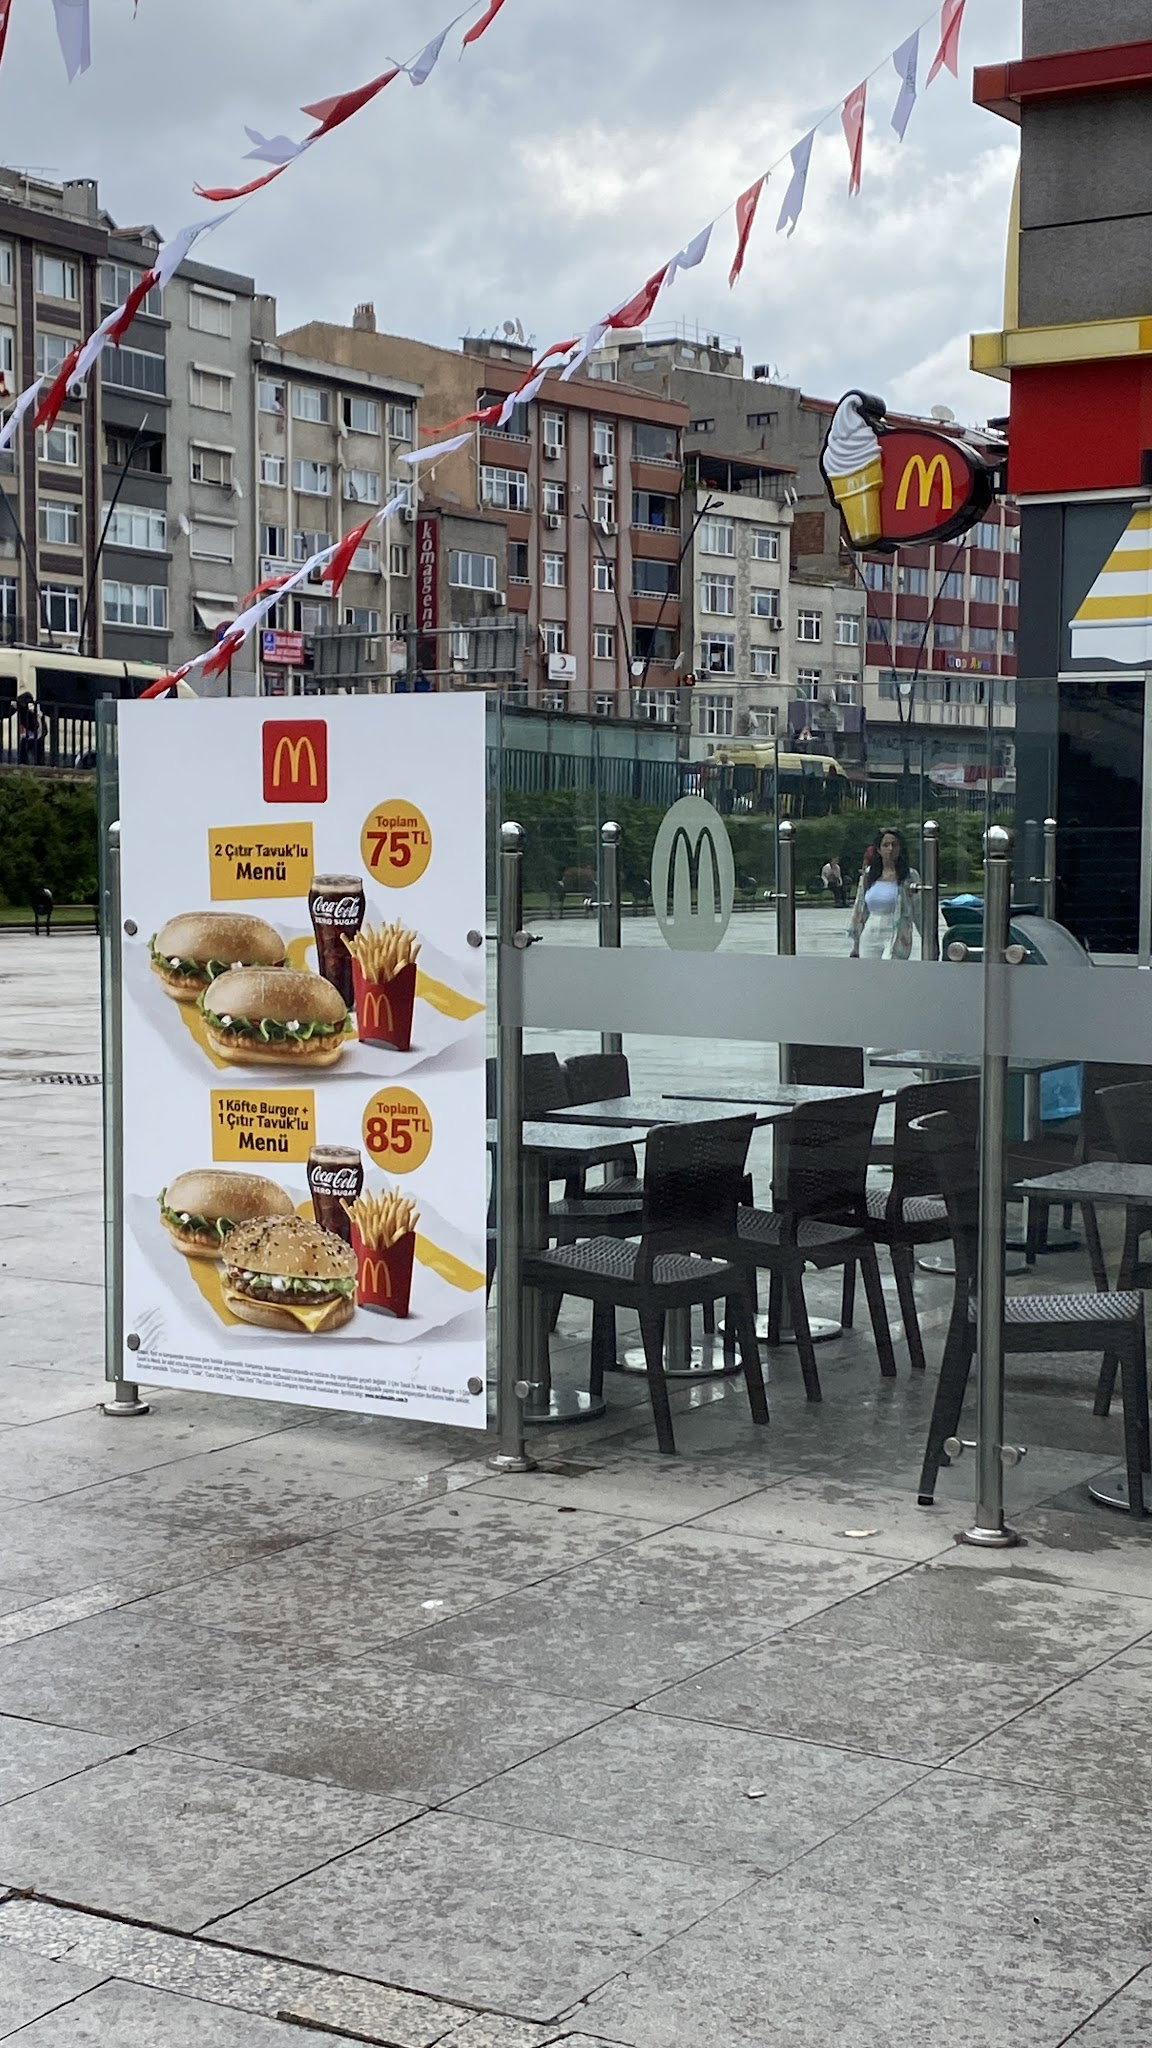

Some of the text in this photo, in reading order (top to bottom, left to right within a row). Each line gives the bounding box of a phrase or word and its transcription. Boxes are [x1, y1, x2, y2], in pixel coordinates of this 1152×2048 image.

[896, 454, 952, 510] M
[272, 736, 317, 786] M
[375, 815, 418, 830] Toplam
[215, 844, 308, 861] 2 Çıtır Tavuk'lu
[236, 862, 286, 881] Menü
[315, 917, 359, 926] ZERO SUGAR
[218, 1100, 224, 1110] 1
[226, 1100, 257, 1113] Köfte
[260, 1102, 299, 1118] Burger
[376, 1102, 418, 1117] Toplam
[218, 1113, 309, 1131] 1 Çıtır Tavuk'lu
[239, 1131, 289, 1153] Menü
[313, 1186, 357, 1197] ZERO SUGAR
